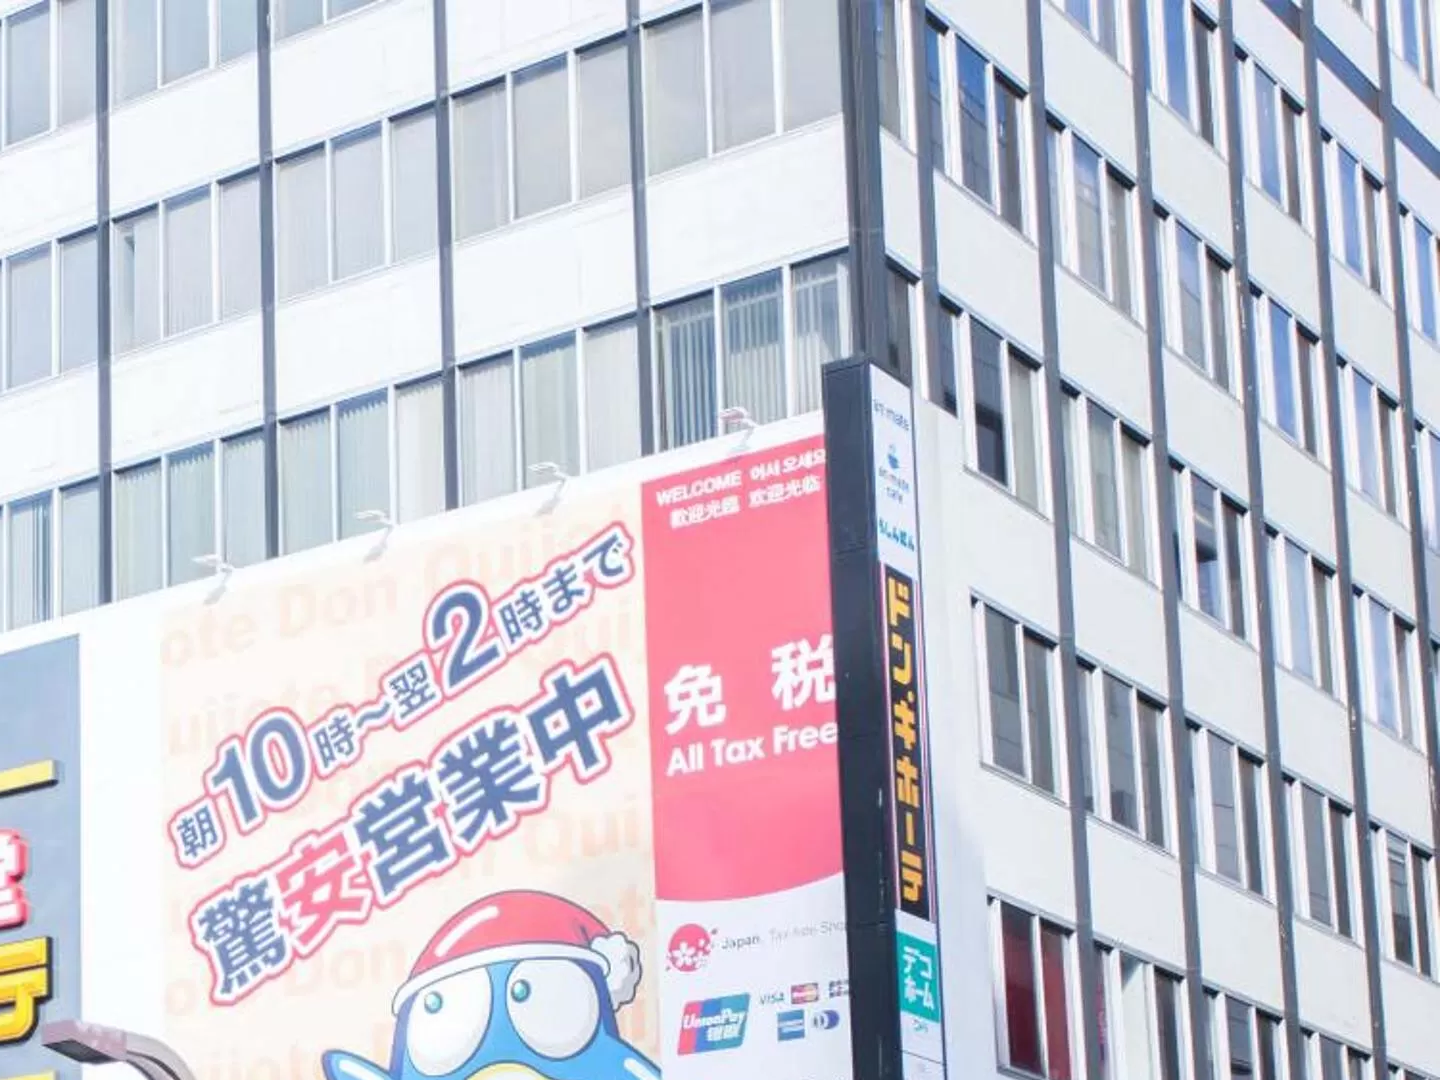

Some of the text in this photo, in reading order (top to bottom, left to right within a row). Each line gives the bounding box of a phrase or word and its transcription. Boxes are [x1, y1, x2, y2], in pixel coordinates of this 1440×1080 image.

[656, 470, 743, 507] WELCOME
[667, 722, 839, 777] All Tax Free
[197, 662, 625, 995] 驚安営業中
[903, 946, 933, 980] デコ
[903, 975, 935, 1011] ホーム
[684, 1007, 747, 1030] UnionPay
